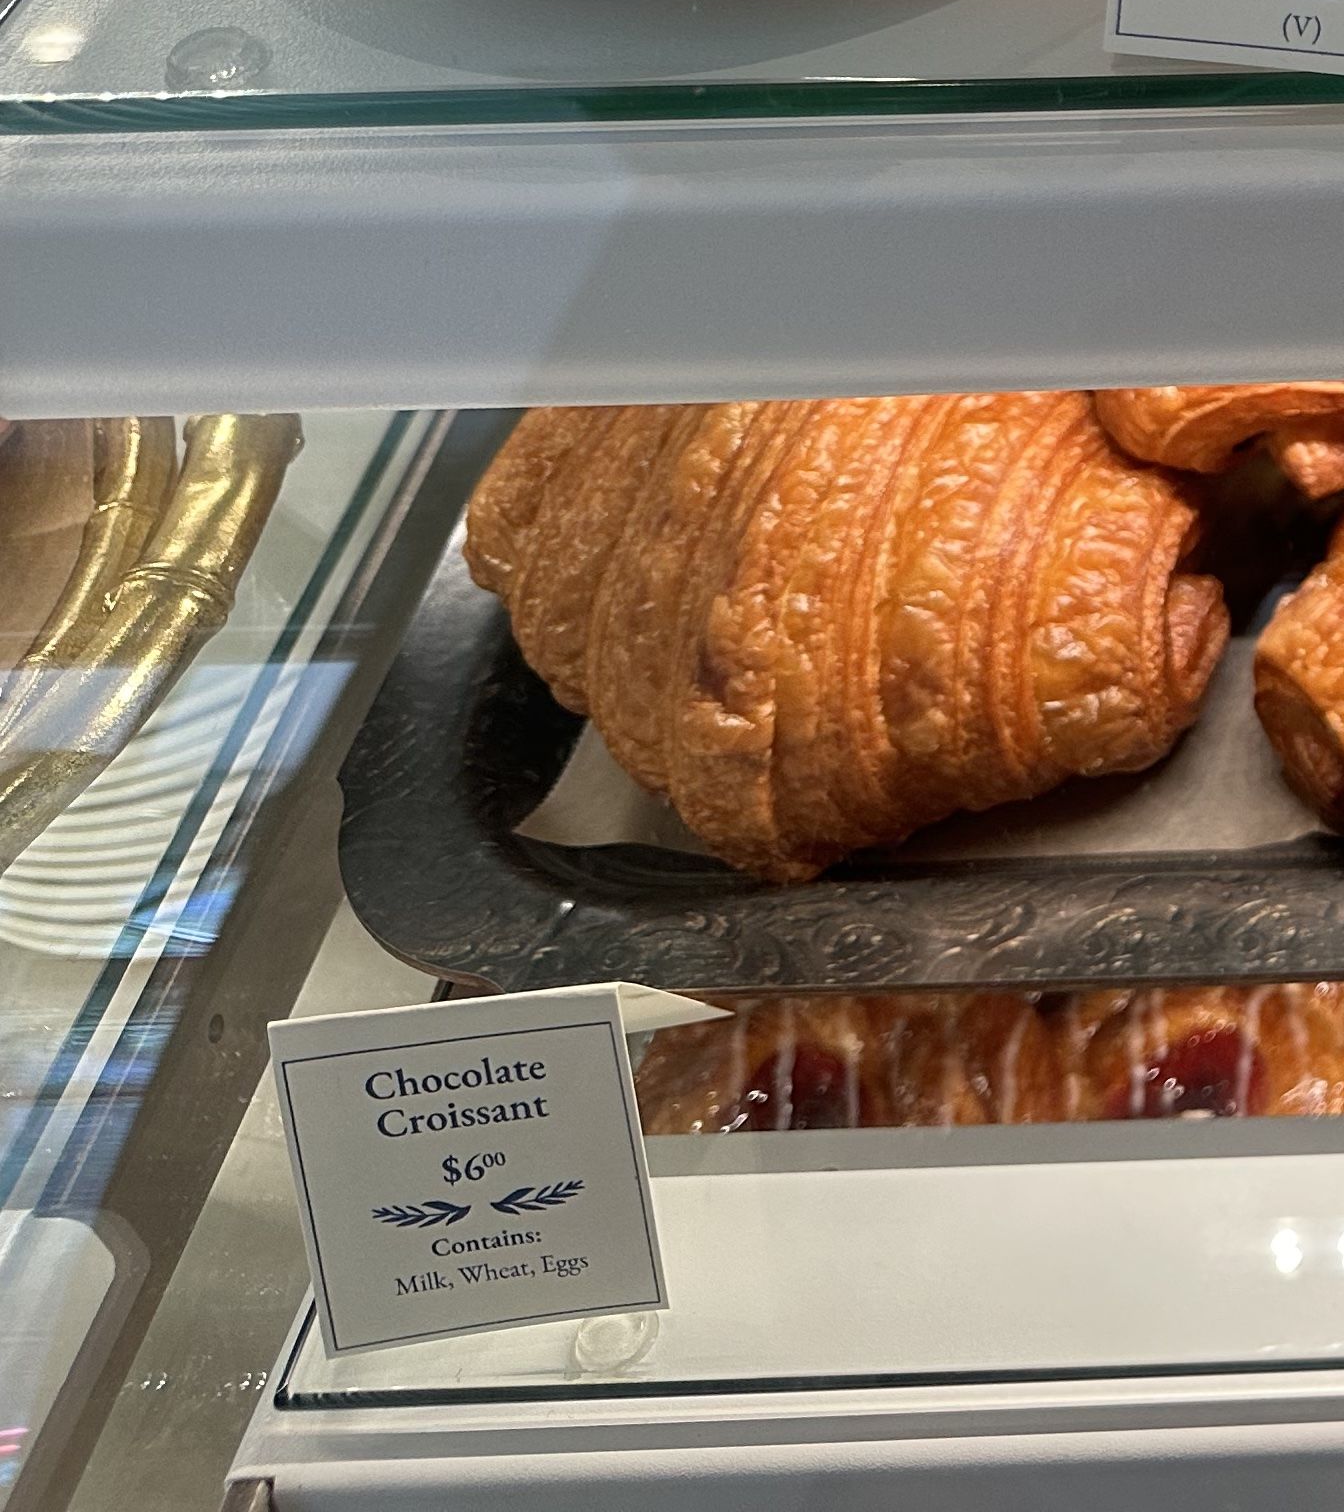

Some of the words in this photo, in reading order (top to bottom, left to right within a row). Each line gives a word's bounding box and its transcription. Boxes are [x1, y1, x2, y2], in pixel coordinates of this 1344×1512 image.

[1282, 12, 1322, 46] (V)
[365, 1056, 547, 1100] Chocolate
[376, 1096, 550, 1138] Croissant
[431, 1229, 542, 1257] Contains:
[394, 1270, 455, 1297] Milk,
[457, 1263, 536, 1284] Wheat,
[539, 1254, 589, 1278] Eggs
